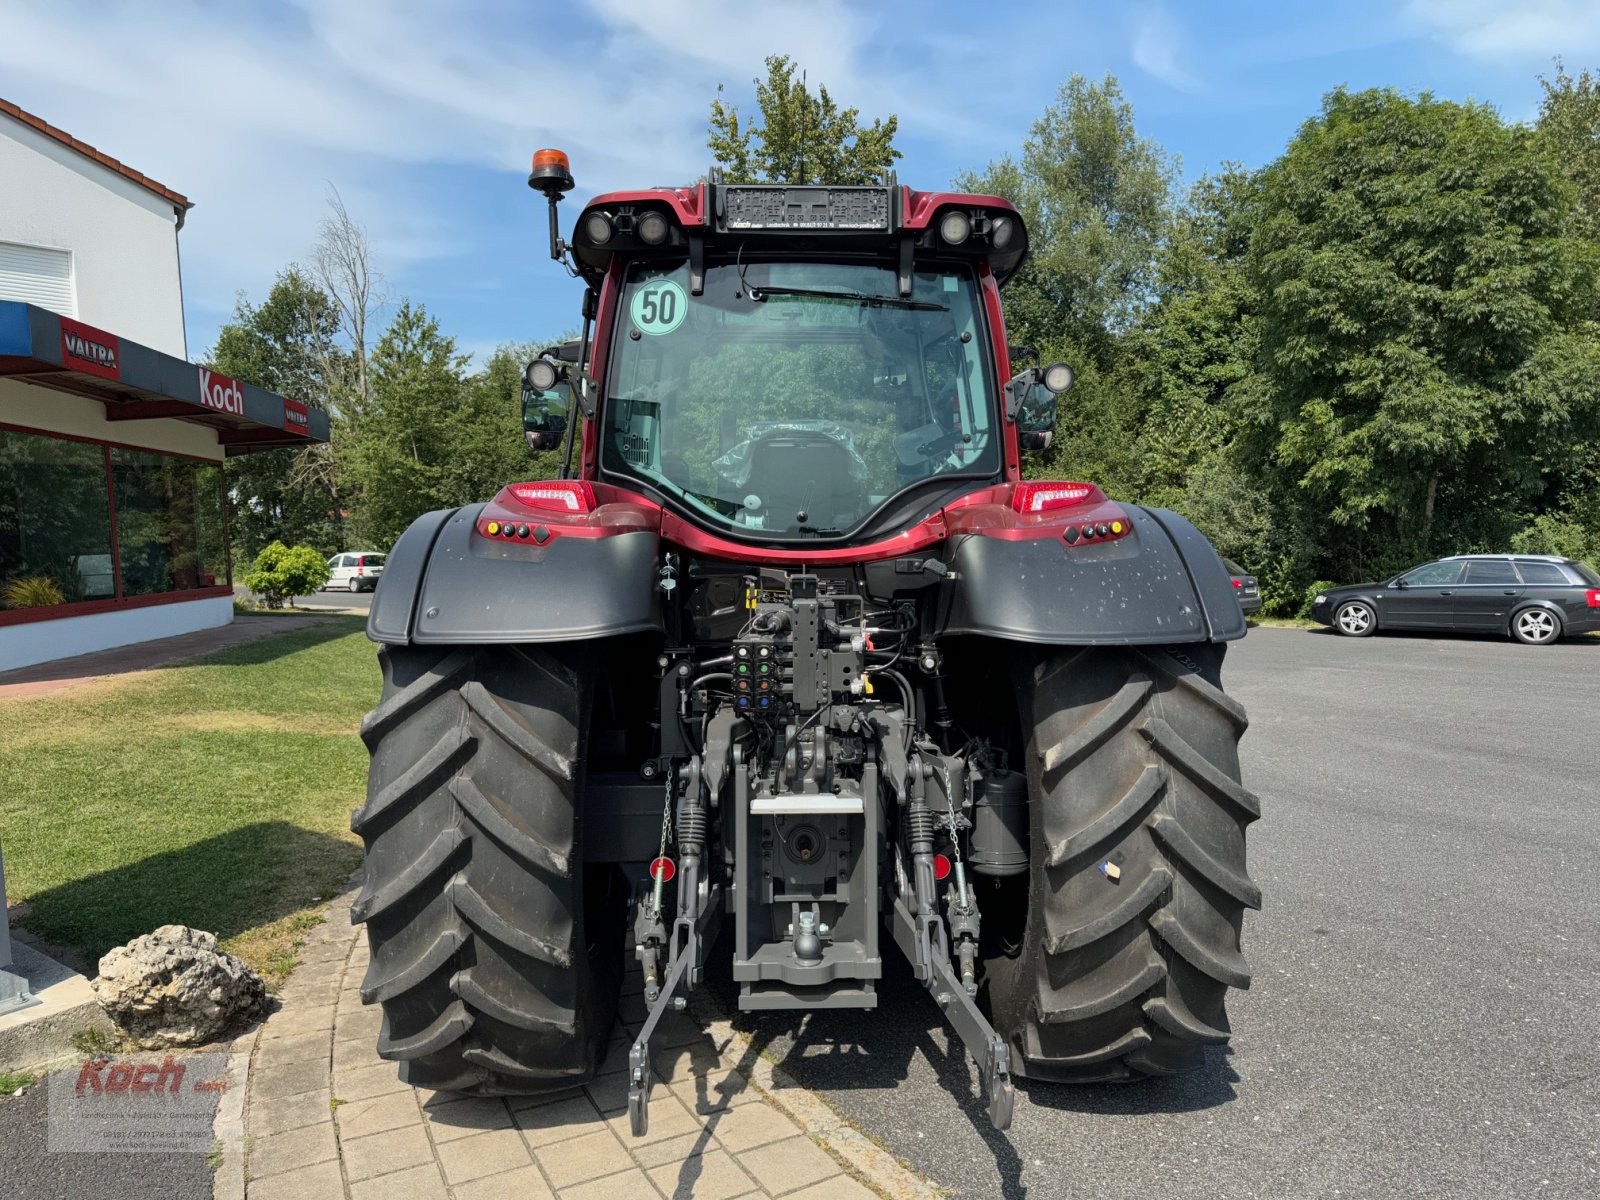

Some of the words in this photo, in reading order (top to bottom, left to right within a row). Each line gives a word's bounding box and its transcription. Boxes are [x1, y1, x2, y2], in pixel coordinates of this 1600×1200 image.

[641, 289, 676, 325] 50
[63, 329, 116, 368] VALTRA
[198, 367, 244, 415] Koch
[285, 406, 308, 425] VALTRA
